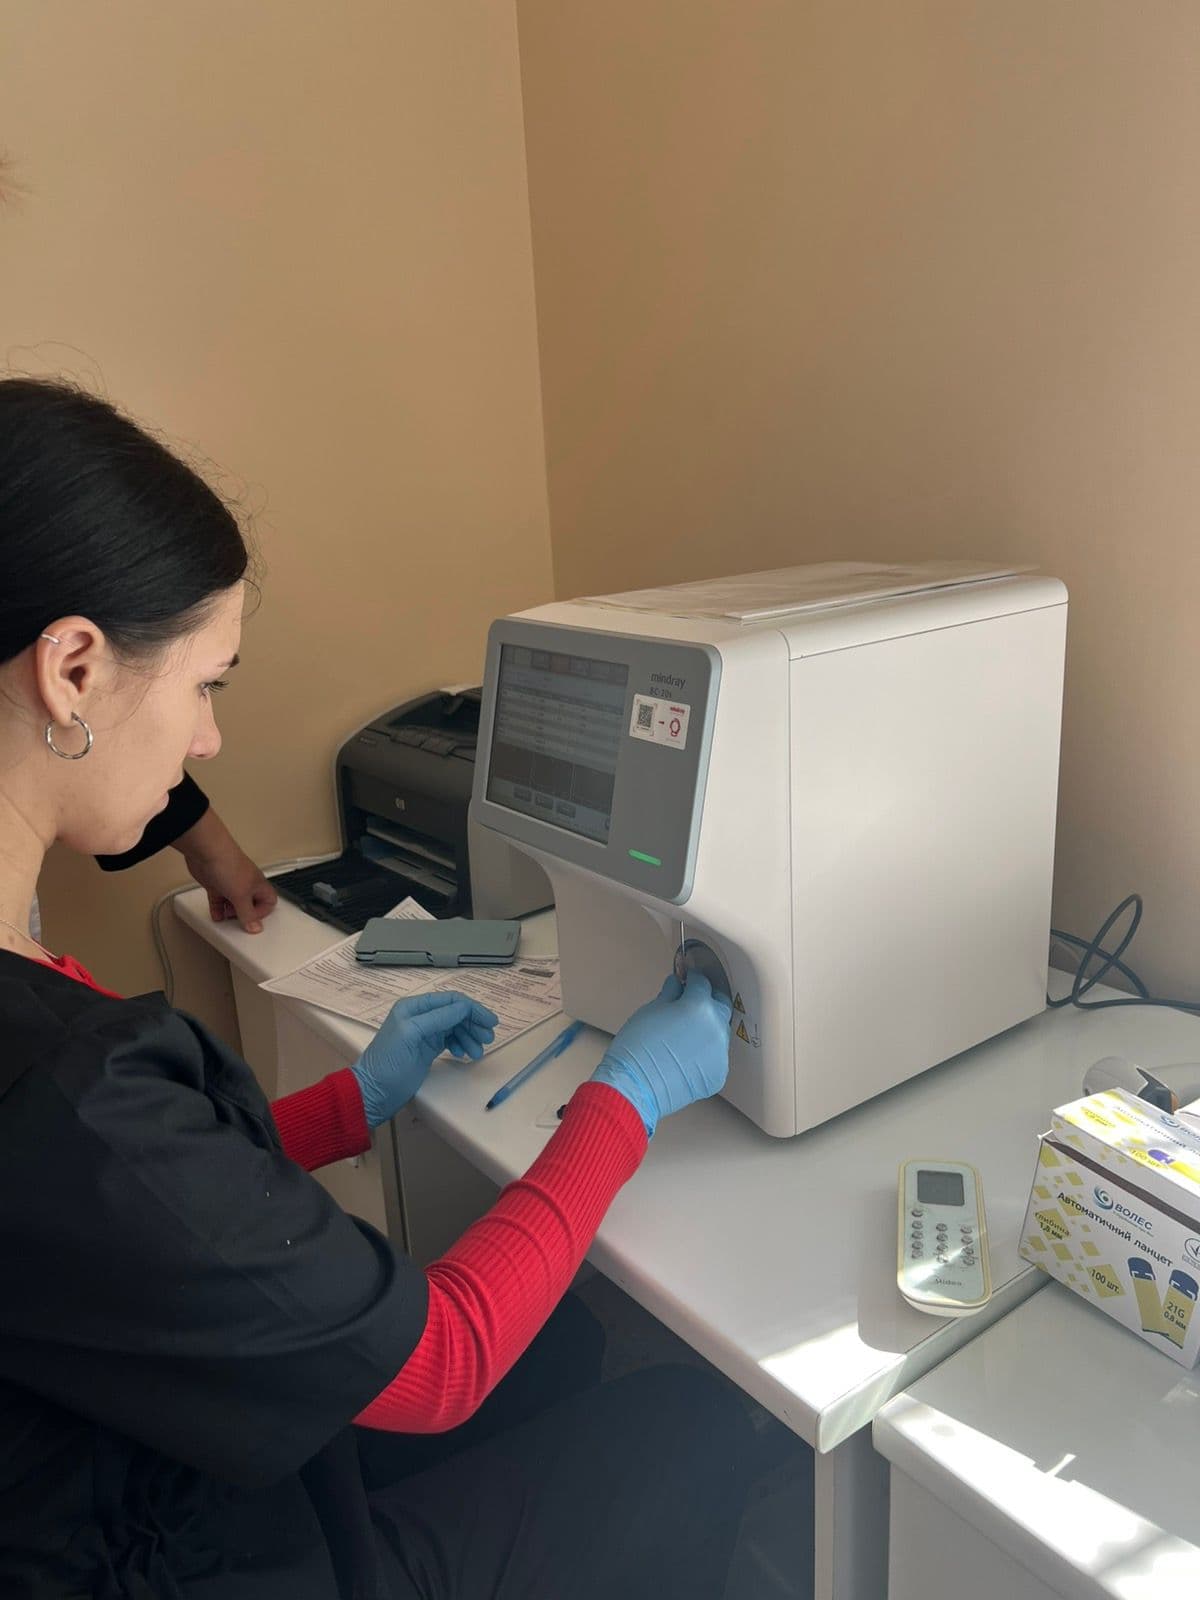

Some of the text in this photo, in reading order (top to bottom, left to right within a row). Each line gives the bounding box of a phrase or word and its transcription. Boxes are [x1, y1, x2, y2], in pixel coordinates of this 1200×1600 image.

[651, 672, 686, 689] mindray
[1114, 1203, 1153, 1231] ВОЛЕС
[1057, 1192, 1131, 1242] Автоматичний
[1134, 1239, 1173, 1267] ланцет
[1091, 1269, 1120, 1294] 100 шт.
[1167, 1301, 1185, 1318] 21G
[1175, 1319, 1186, 1330] мм
